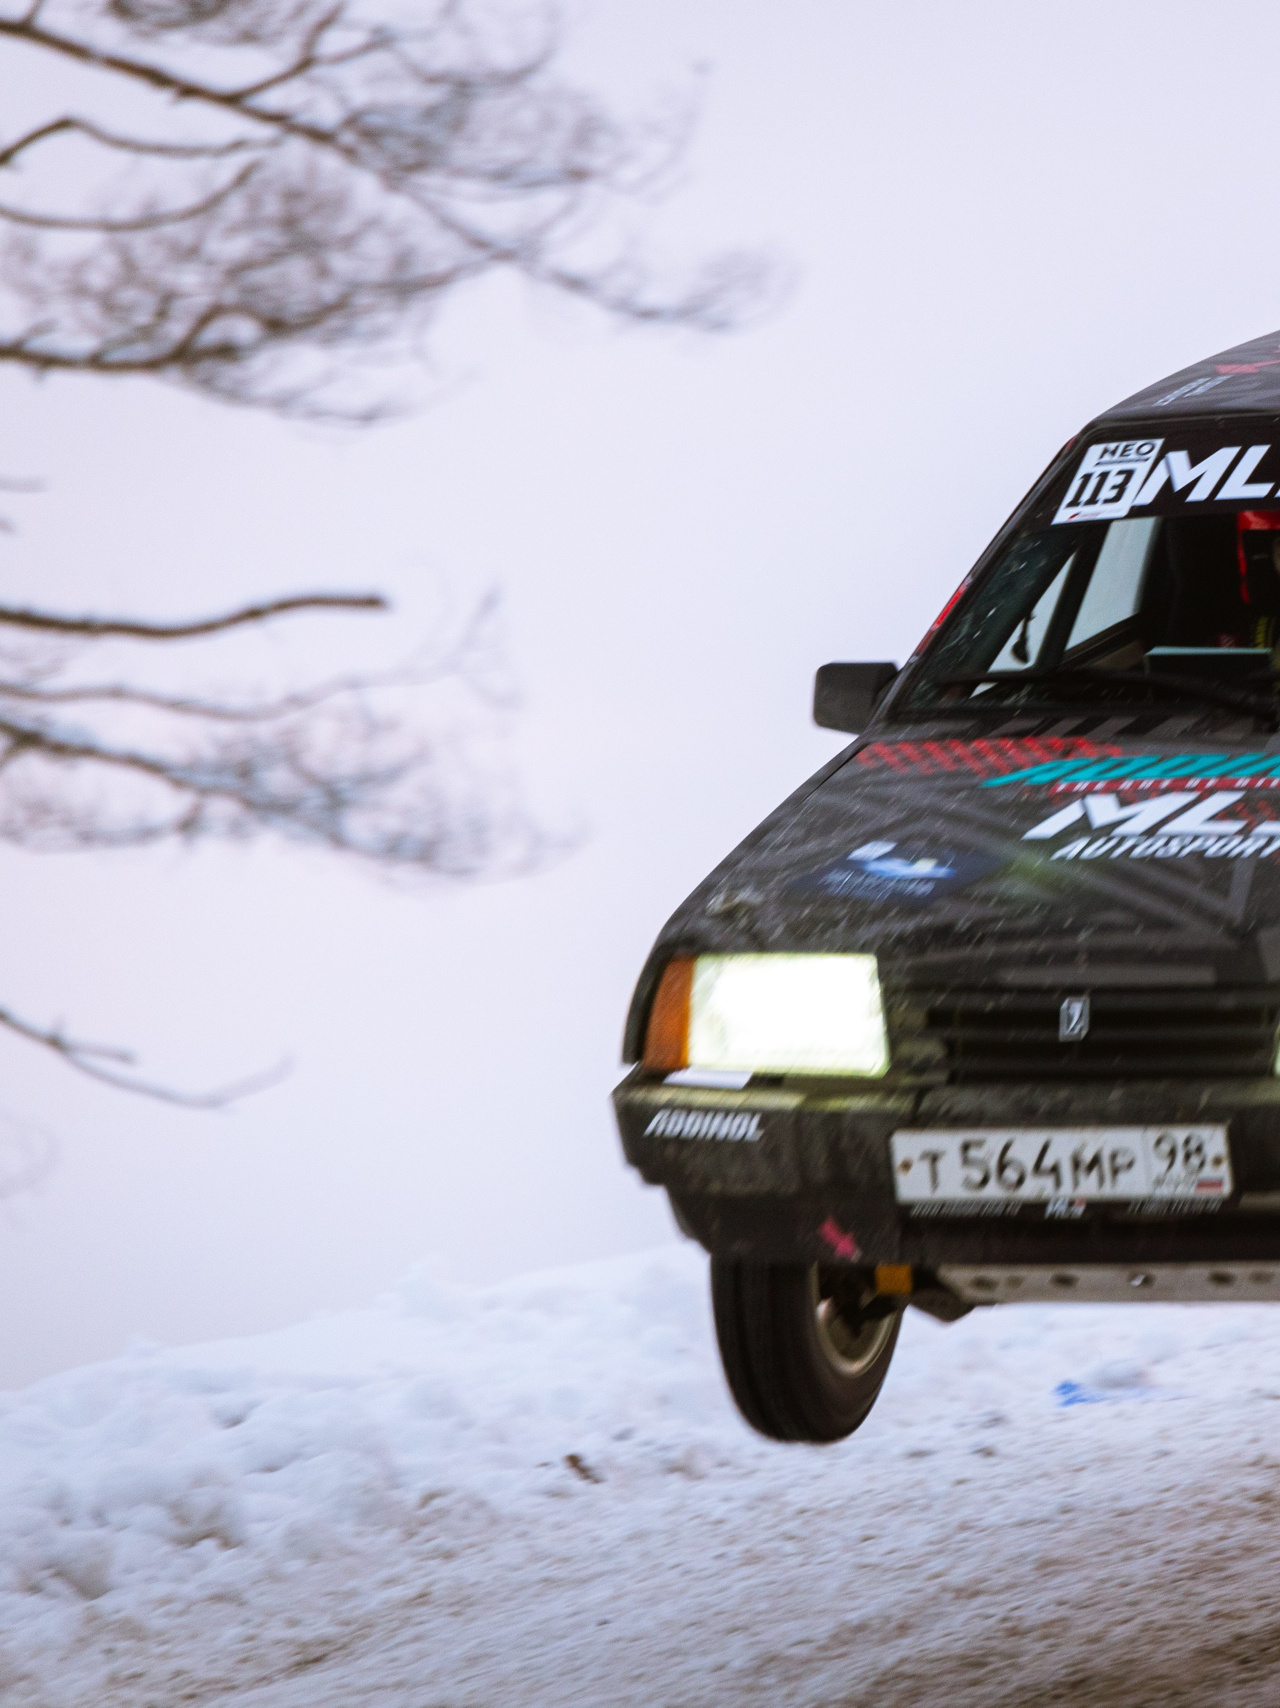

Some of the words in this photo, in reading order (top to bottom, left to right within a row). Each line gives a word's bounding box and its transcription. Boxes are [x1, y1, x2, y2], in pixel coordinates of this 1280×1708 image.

[1100, 442, 1156, 459] NEO
[1063, 468, 1137, 508] 113
[643, 1108, 765, 1141] ADDINOL
[1153, 1131, 1206, 1174] 98
